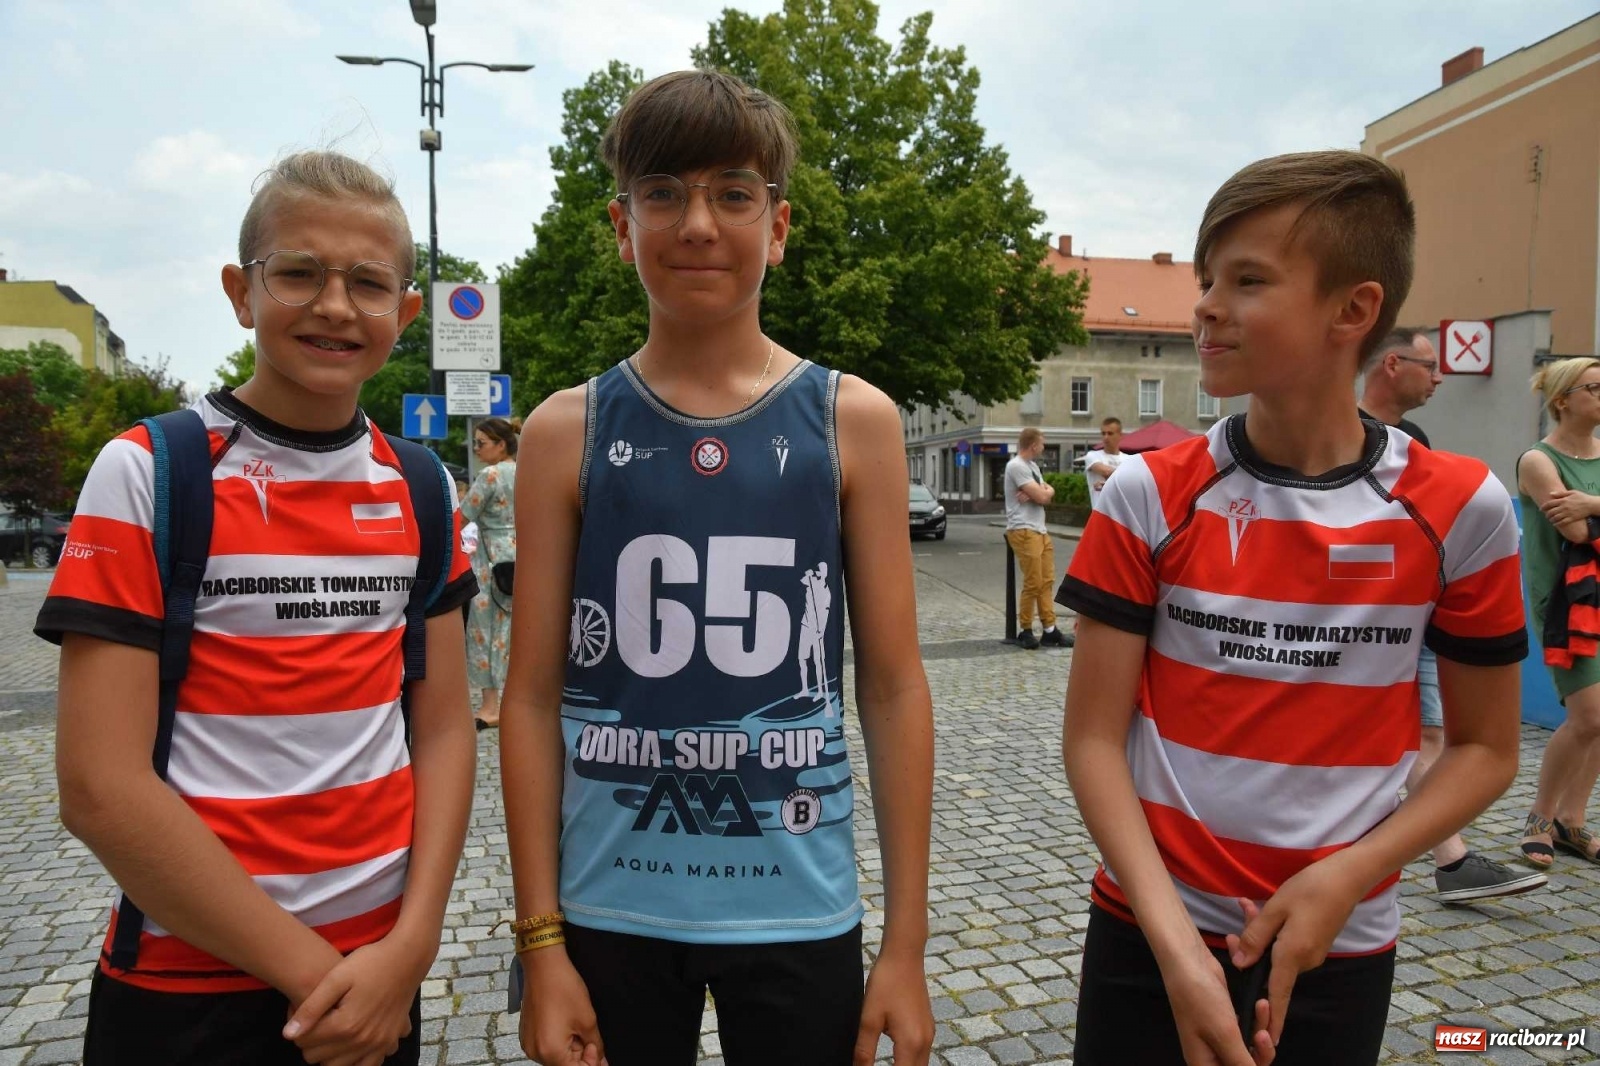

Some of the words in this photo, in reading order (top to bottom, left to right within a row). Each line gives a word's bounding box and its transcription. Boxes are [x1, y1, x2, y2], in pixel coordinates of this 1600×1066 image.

[66, 547, 94, 559] SUP
[203, 577, 316, 596] RACIBORSKIE
[275, 599, 381, 619] WIOŚLARSKIE
[615, 533, 796, 678] 65
[1167, 603, 1267, 638] RACIBORSKIE
[1273, 623, 1412, 644] TOWARZYSTWO
[1219, 640, 1342, 667] WIOŚLARSKIE
[579, 723, 662, 768] ODRA
[674, 731, 748, 770] SUP
[760, 728, 826, 769] CUP
[614, 856, 674, 875] AQUA
[687, 864, 782, 878] MARINA
